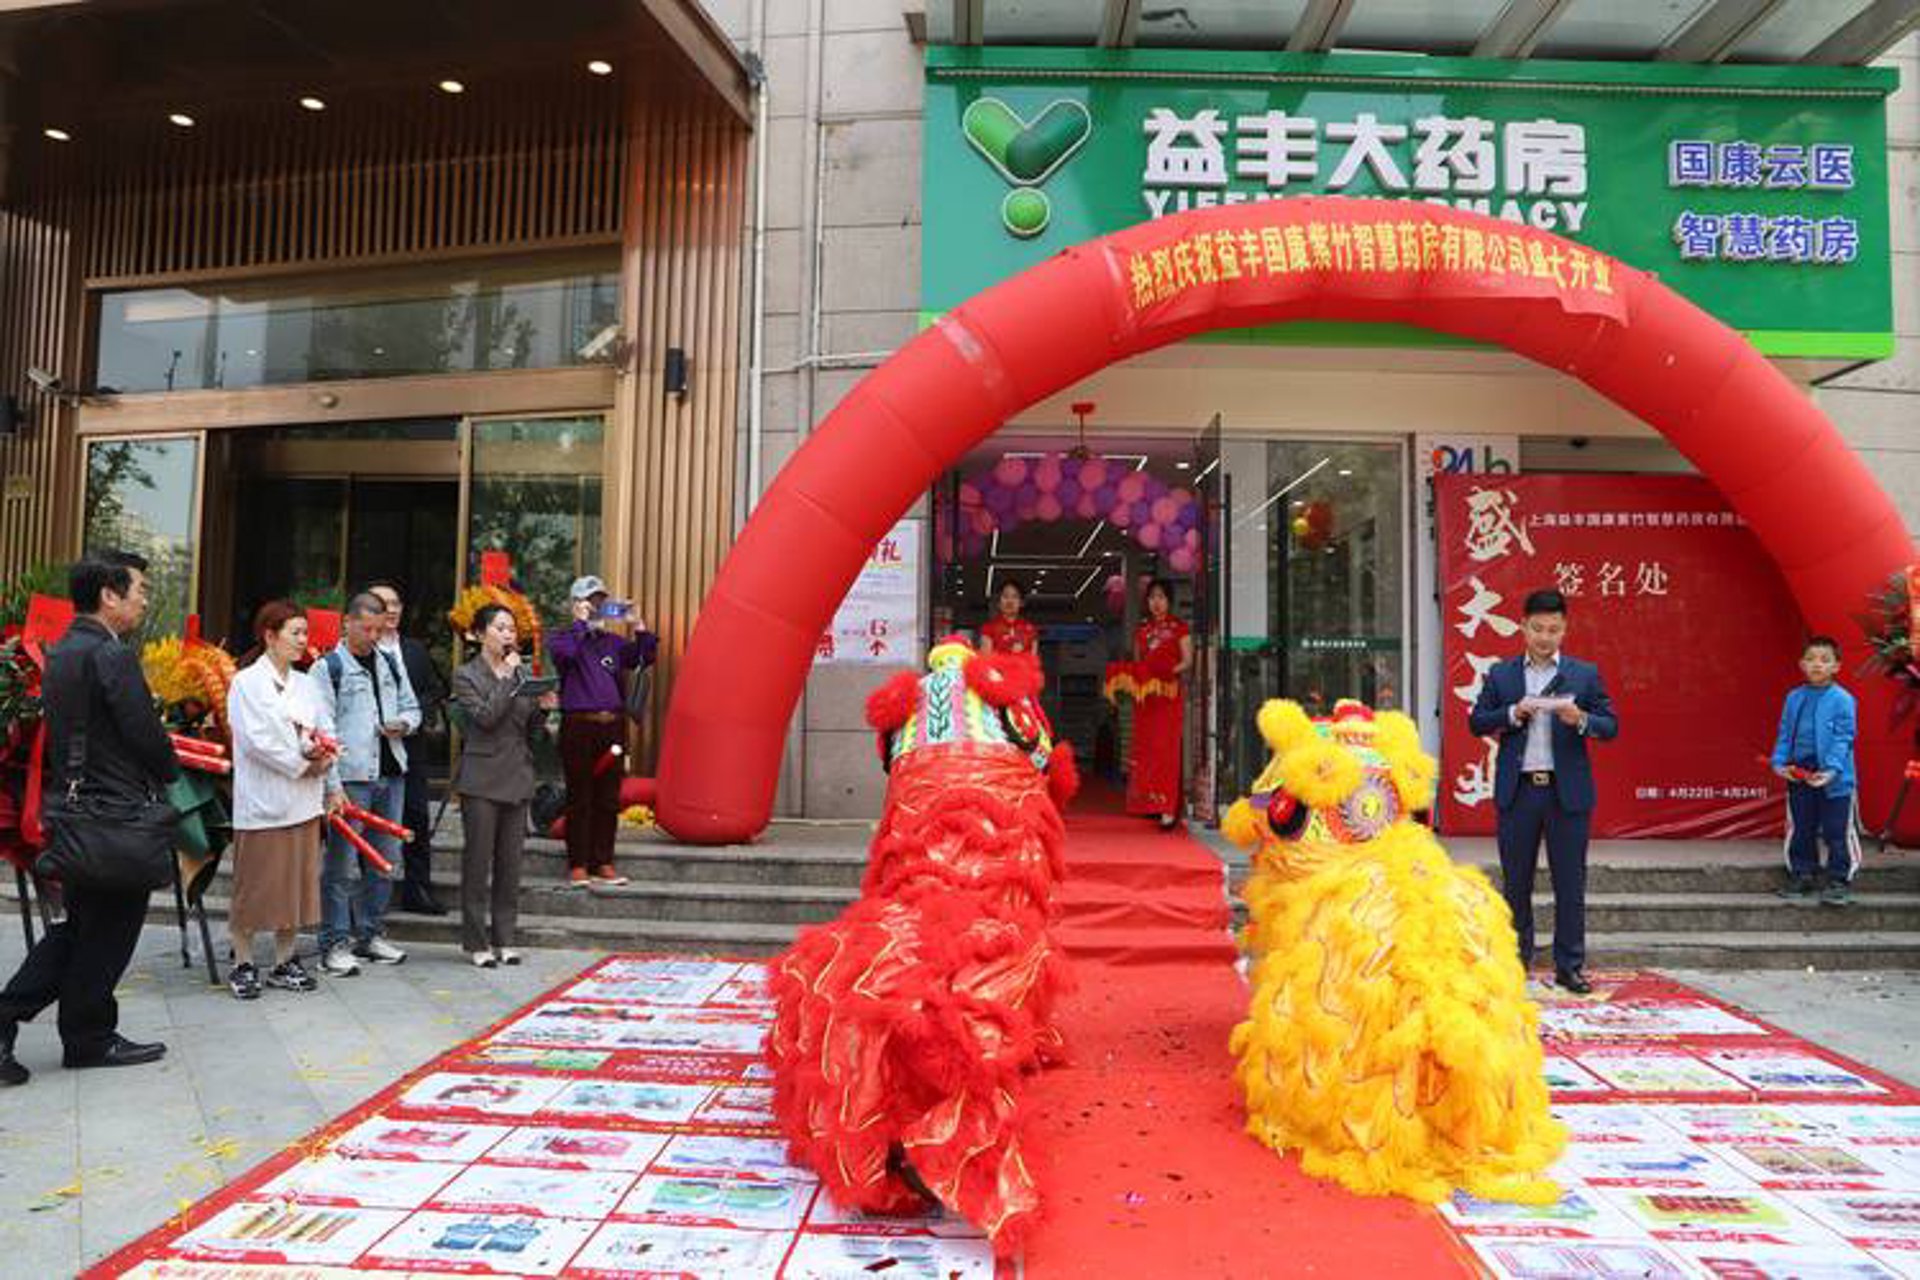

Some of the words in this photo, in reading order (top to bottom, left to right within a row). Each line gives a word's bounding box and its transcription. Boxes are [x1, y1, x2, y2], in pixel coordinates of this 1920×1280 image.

[1143, 107, 1588, 197] 益丰大药房
[1669, 140, 1855, 189] 国康云医
[1676, 211, 1857, 264] 智慧药房
[1555, 562, 1669, 596] 签名处
